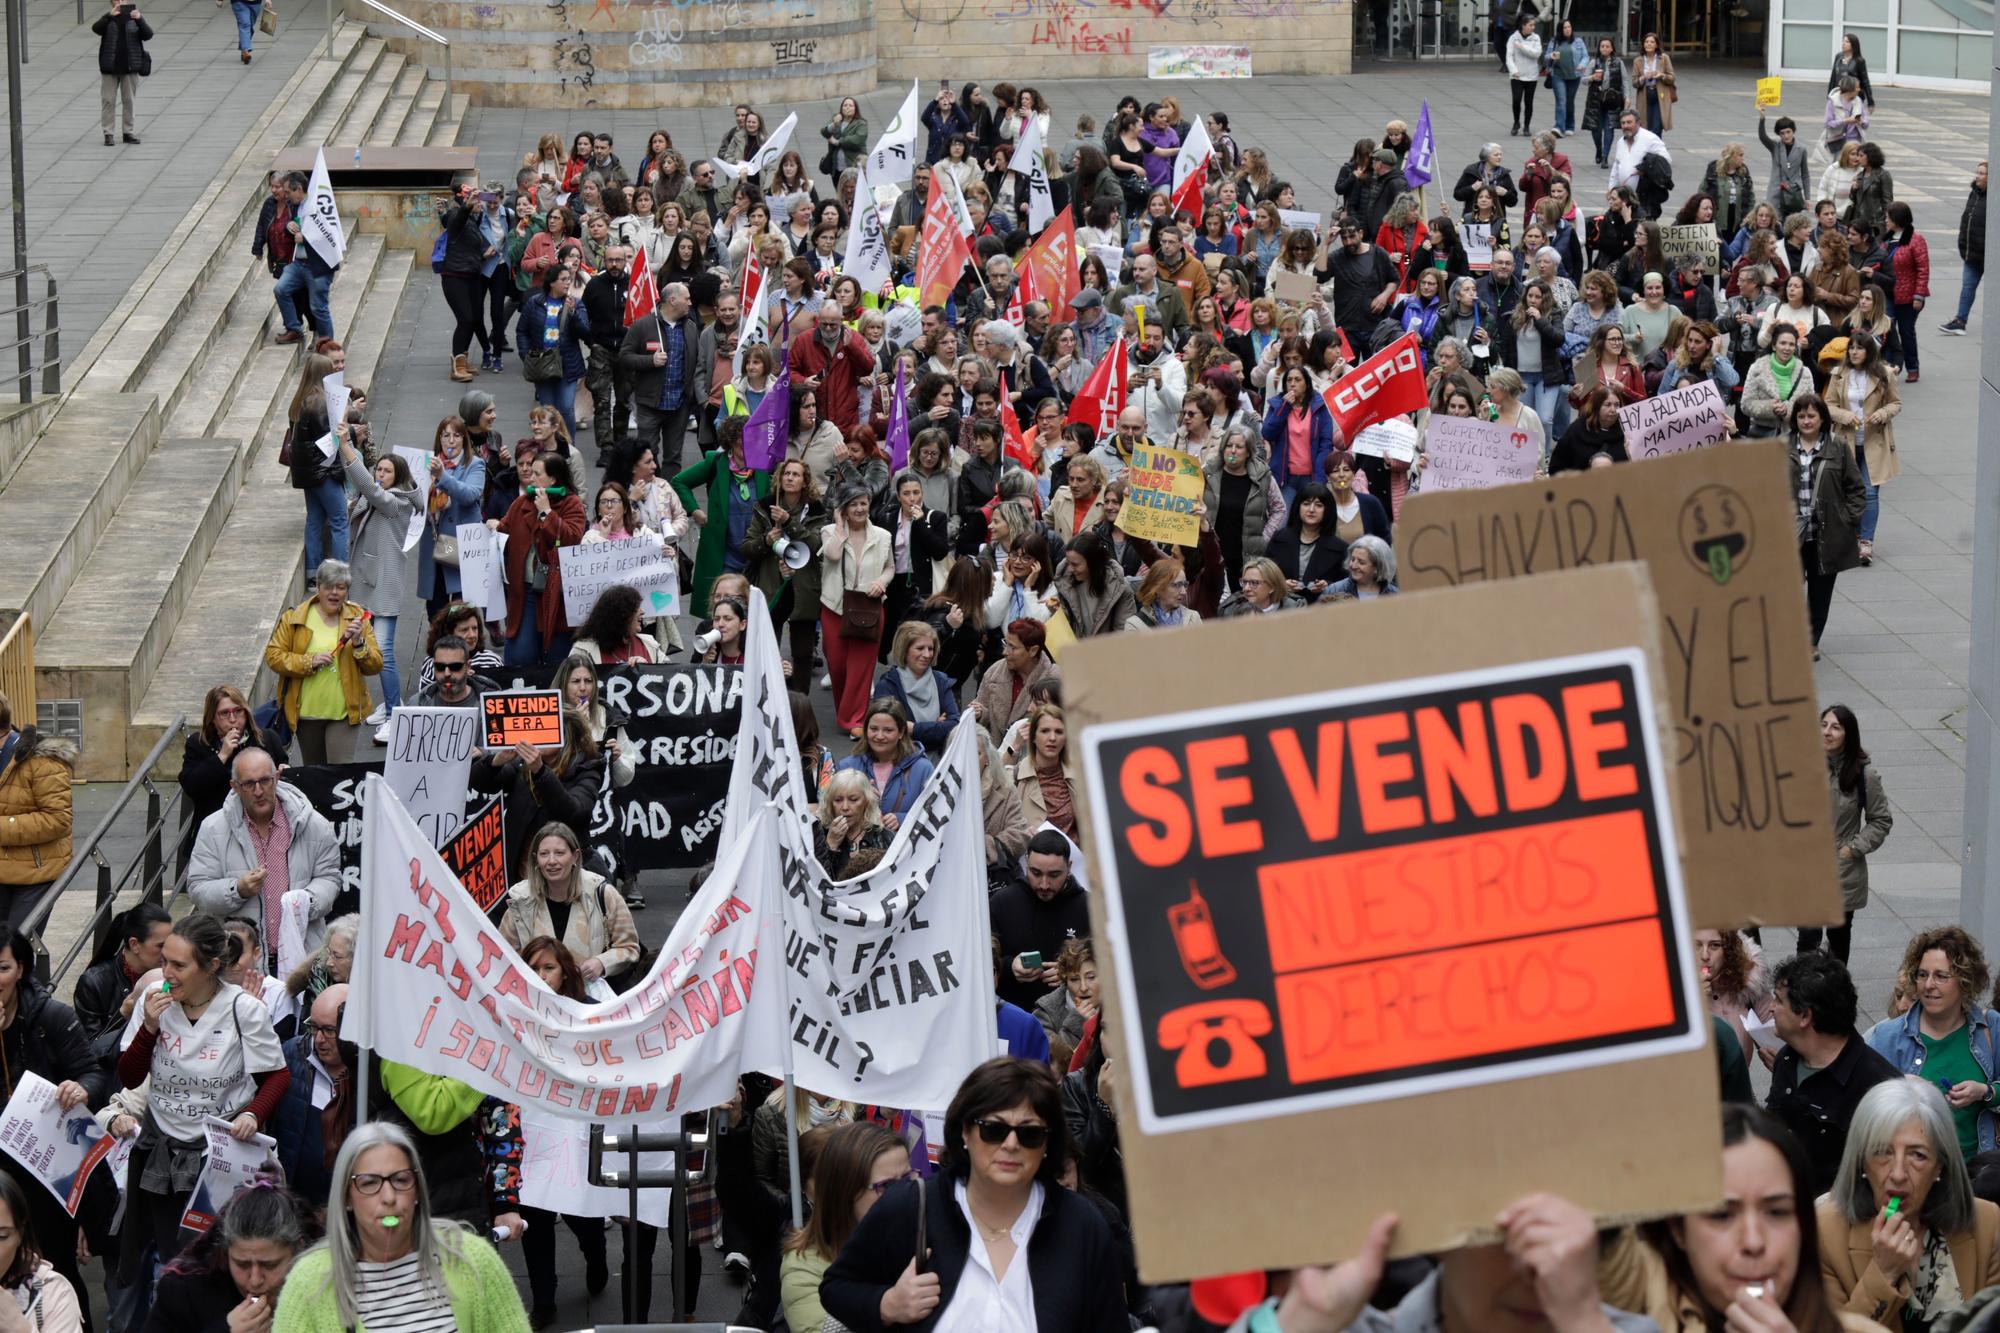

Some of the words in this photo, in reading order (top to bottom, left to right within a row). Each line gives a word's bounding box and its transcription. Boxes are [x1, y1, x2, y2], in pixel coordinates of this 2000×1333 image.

[310, 212, 337, 248] Asturias
[1661, 226, 1708, 240] SPETEN
[1663, 240, 1717, 253] ONVENIO
[1334, 347, 1417, 414] CCOO
[1618, 405, 1641, 432] HOY
[1648, 385, 1717, 420] PALMADA
[1644, 407, 1718, 448] MAÑANA
[1151, 453, 1176, 473] NO
[1131, 488, 1197, 516] EFIENDE
[463, 528, 482, 542] NO
[572, 545, 588, 558] LA
[592, 534, 653, 555] GERENCIA
[1408, 490, 1641, 586] SHAKIRA
[567, 564, 586, 578] DEL
[1665, 606, 1700, 720] Y
[1727, 595, 1809, 709] EL
[486, 701, 504, 715] SE
[507, 697, 559, 713] VENDE
[393, 713, 474, 763] DERECHO
[513, 718, 545, 729] ERA
[1119, 734, 1263, 867] SE
[1268, 680, 1639, 842] VENDE
[410, 775, 429, 802] A
[453, 804, 501, 871] VENDE
[465, 853, 496, 896] ERA
[1273, 829, 1600, 962] NUESTROS
[384, 913, 473, 1001] MAS
[1292, 941, 1600, 1063] DERECHOS
[198, 1046, 219, 1060] SE
[200, 1091, 218, 1101] DE
[9, 1141, 18, 1151] Y
[15, 1118, 33, 1147] JUNTOS
[20, 1133, 39, 1160] SOMOS
[37, 1144, 56, 1174] FUERTES
[210, 1157, 232, 1173] FUERTES
[212, 1146, 224, 1158] MAS
